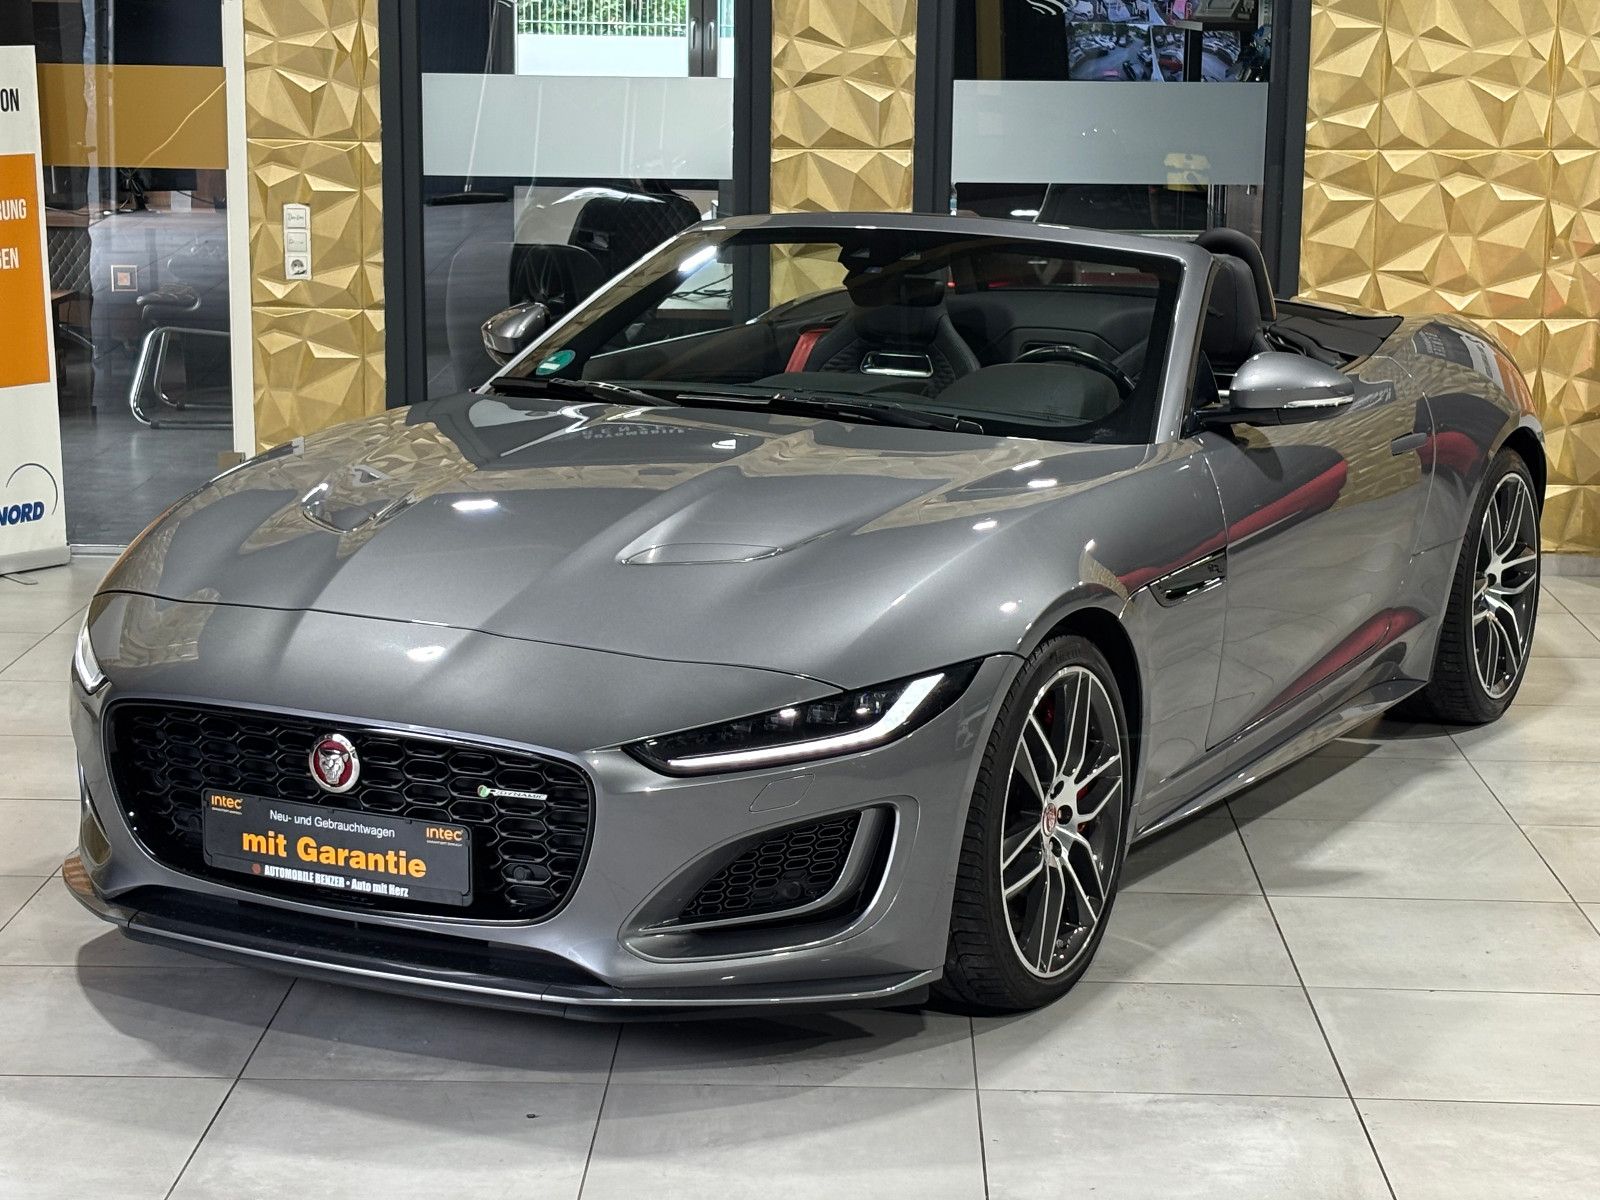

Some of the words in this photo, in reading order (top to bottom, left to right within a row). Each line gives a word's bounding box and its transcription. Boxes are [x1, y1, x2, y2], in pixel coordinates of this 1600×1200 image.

[0, 199, 27, 220] UNG
[0, 247, 20, 270] EN
[0, 501, 45, 526] NORD
[269, 809, 292, 822] Neu-
[294, 815, 312, 826] und
[314, 816, 396, 839] Gebrauchtwagen
[242, 830, 288, 858] mit
[296, 836, 427, 878] Garantie
[264, 864, 314, 883] AUTOMOBILE
[351, 878, 372, 892] Auto
[372, 882, 388, 895] mit
[388, 883, 409, 898] Herz
